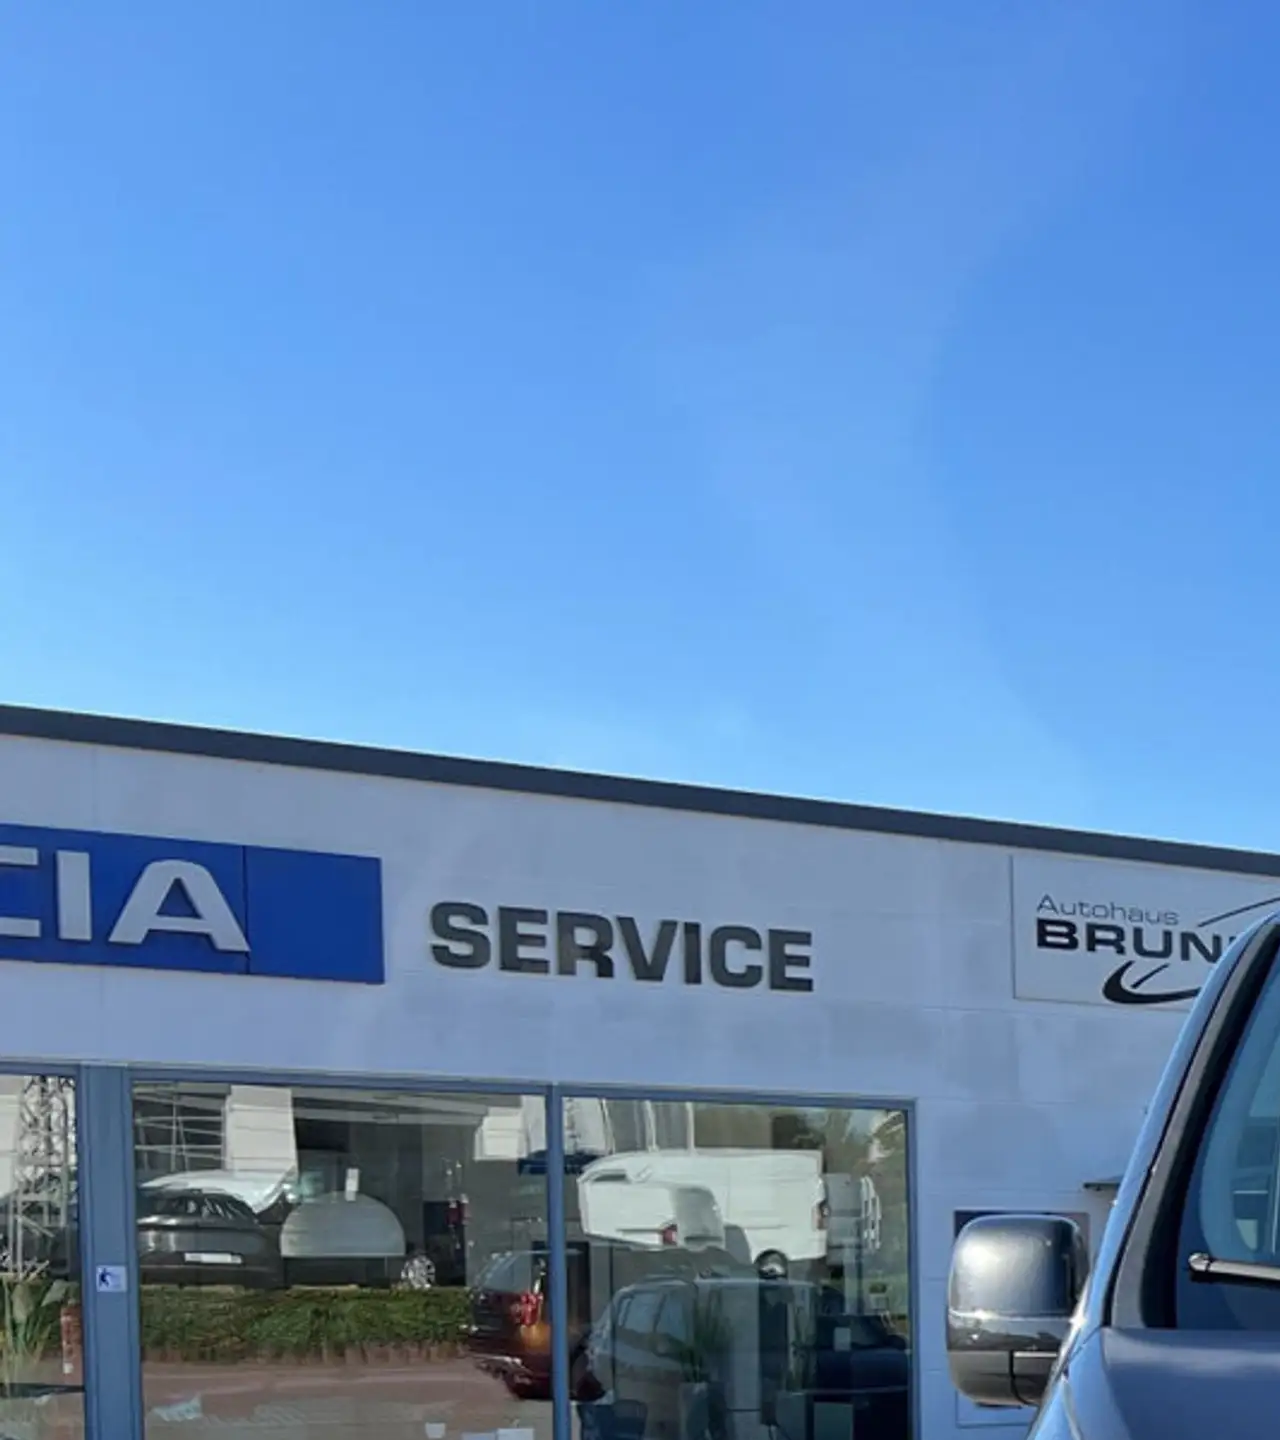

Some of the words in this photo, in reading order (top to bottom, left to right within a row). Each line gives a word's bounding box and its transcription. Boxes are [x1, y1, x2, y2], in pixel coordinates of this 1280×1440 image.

[1036, 894, 1180, 926] Autohaus
[430, 901, 814, 992] SERVICE
[1036, 917, 1236, 964] BRUN
